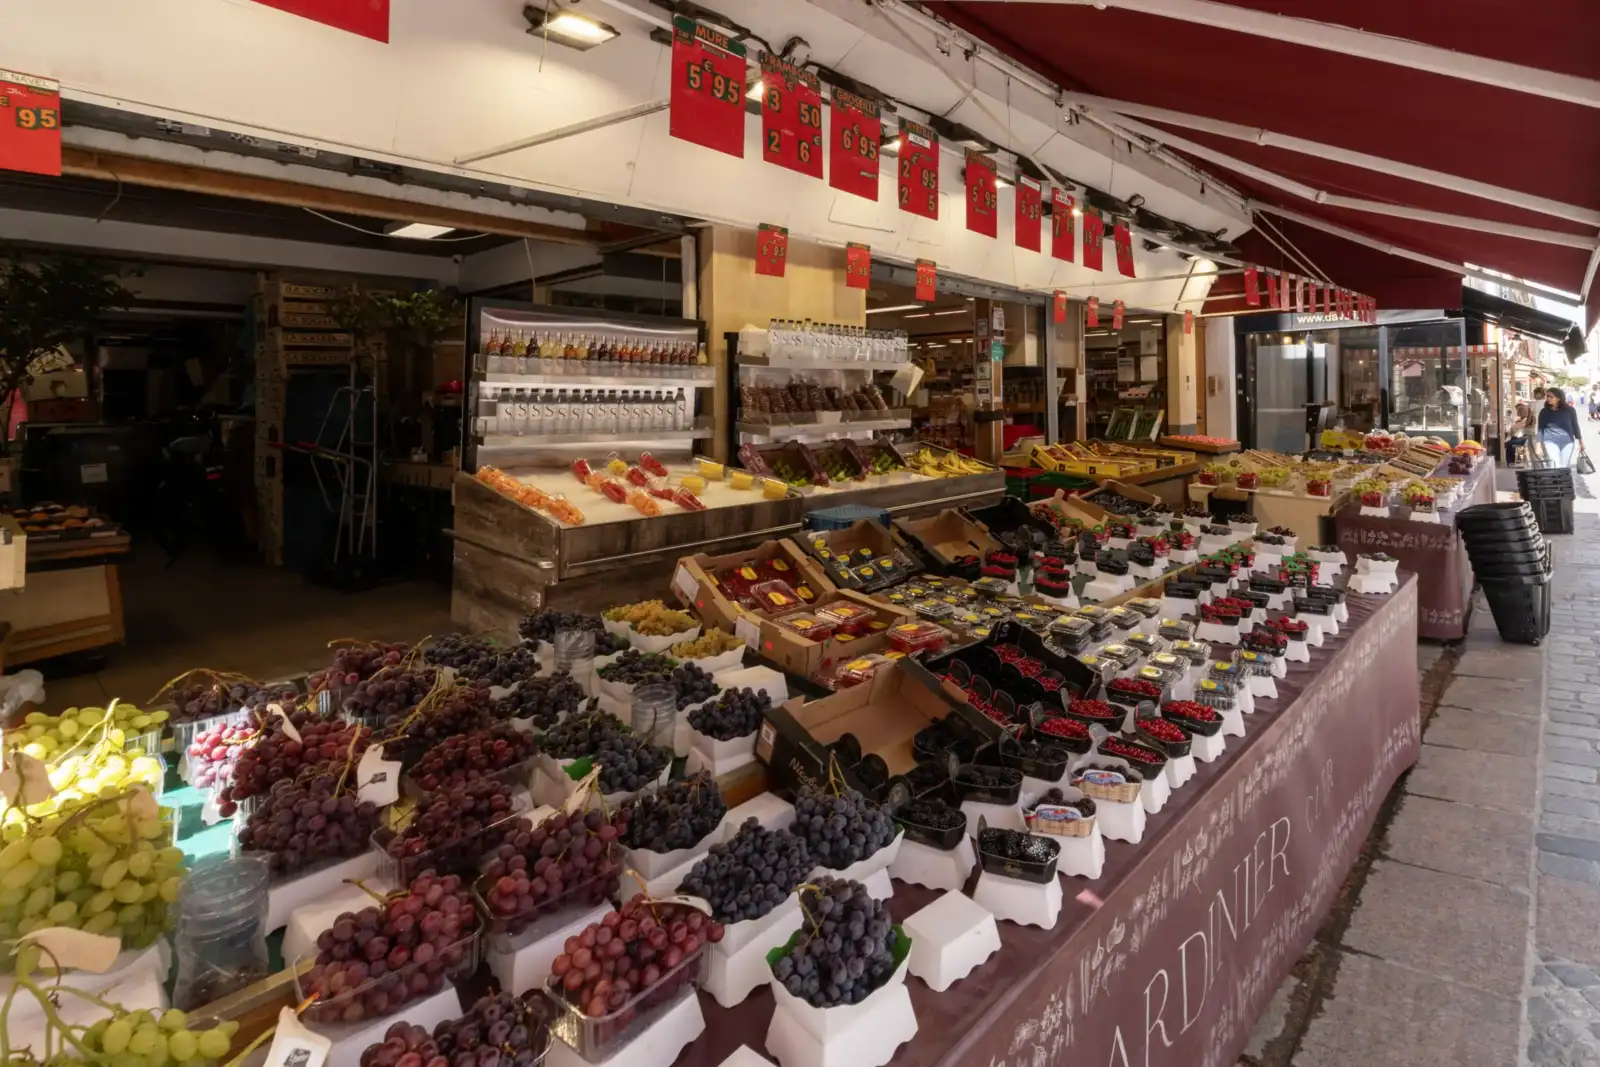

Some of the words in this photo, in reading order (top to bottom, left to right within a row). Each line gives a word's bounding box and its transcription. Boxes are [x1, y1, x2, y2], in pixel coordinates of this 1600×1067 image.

[695, 25, 729, 49] MURE
[11, 74, 49, 87] NAVEL
[690, 65, 700, 88] 5
[713, 75, 739, 104] 95
[18, 108, 57, 128] 95
[769, 89, 781, 112] 3
[800, 102, 820, 128] 50
[769, 131, 780, 154] 2
[800, 142, 810, 162] 6
[843, 129, 852, 149] 6
[859, 135, 877, 160] 95
[921, 168, 936, 190] 95
